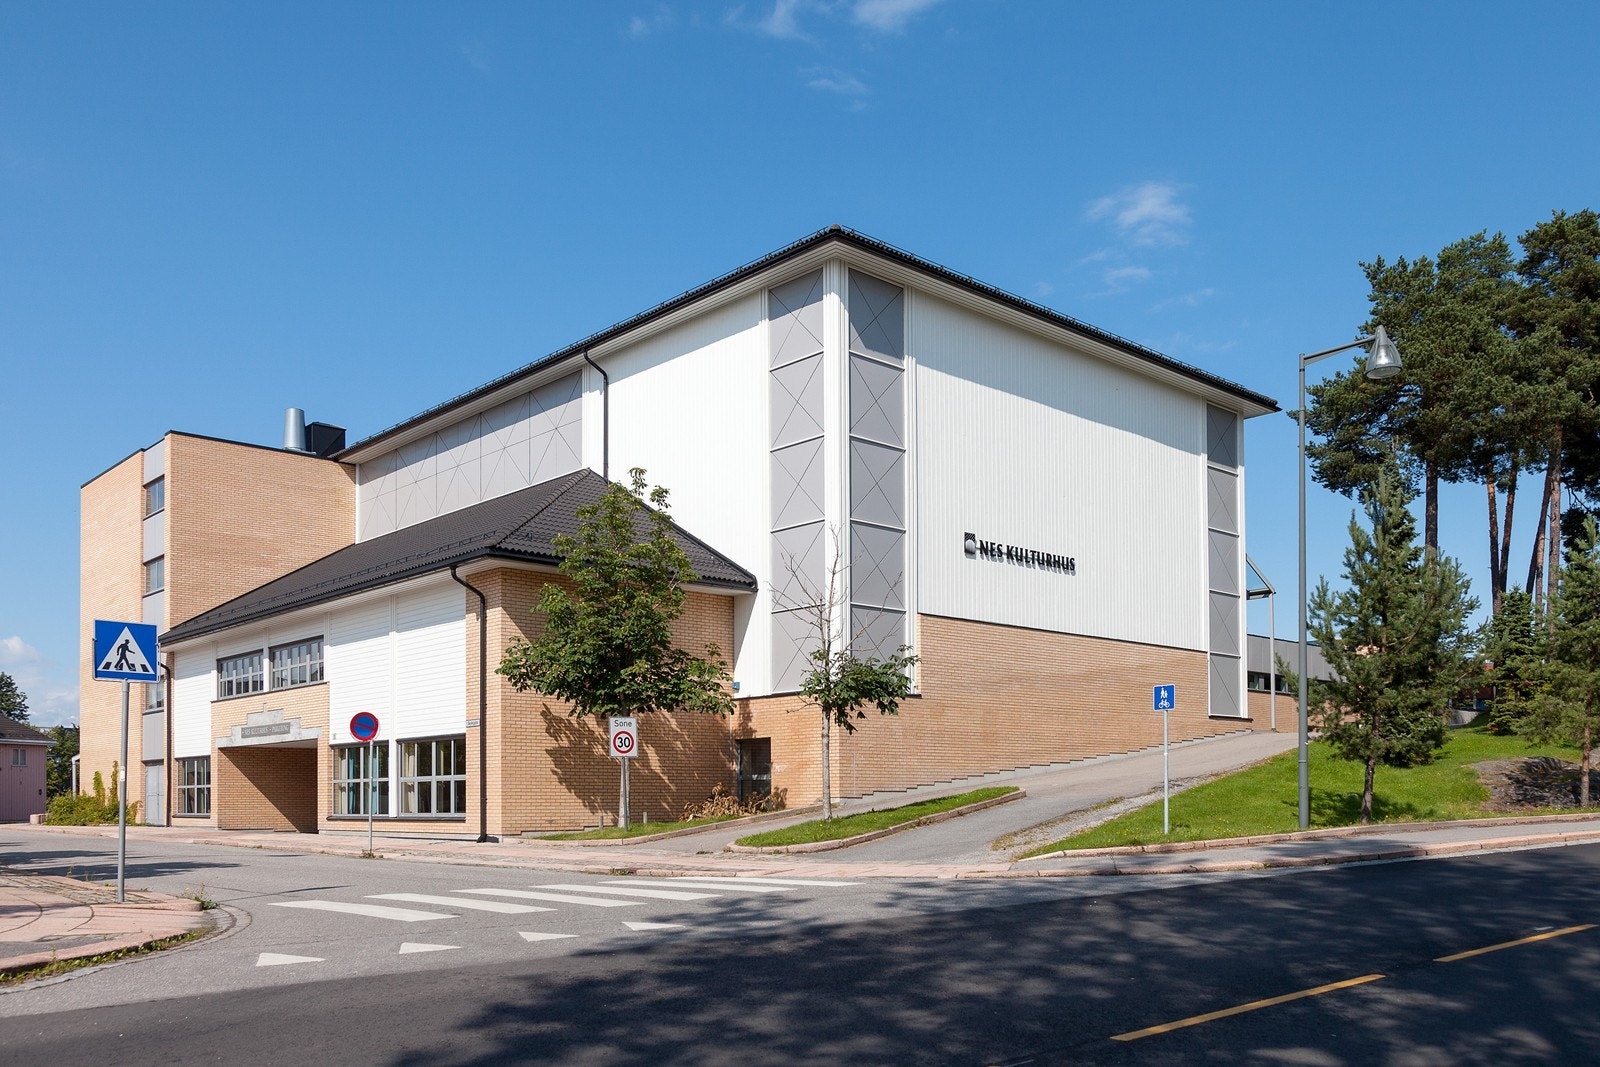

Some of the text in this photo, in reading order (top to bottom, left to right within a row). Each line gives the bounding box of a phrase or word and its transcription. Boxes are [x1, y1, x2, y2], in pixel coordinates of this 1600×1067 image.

[979, 540, 1076, 571] NES KULTURHUS
[617, 737, 630, 748] 30
